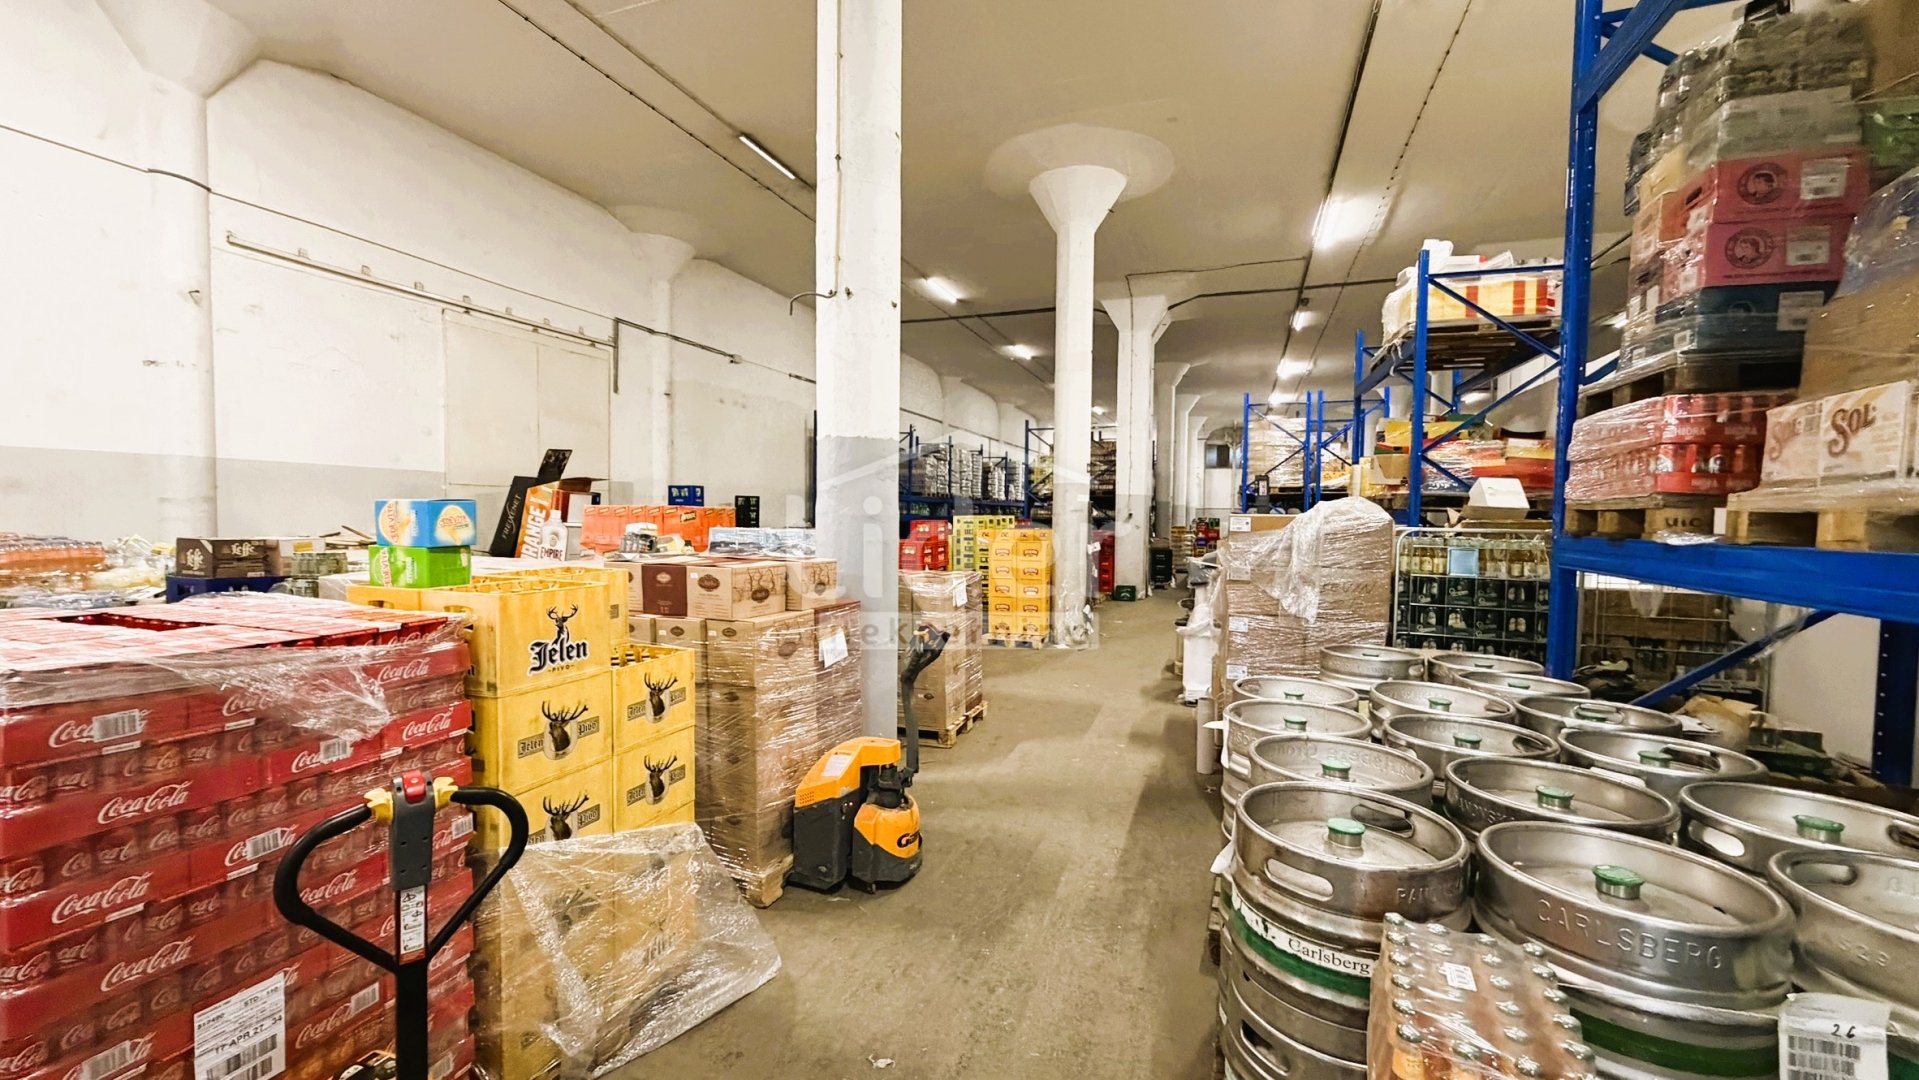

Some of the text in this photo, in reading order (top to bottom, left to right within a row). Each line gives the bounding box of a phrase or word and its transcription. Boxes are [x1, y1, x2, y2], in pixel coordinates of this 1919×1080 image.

[529, 638, 587, 674] Jelen
[1537, 898, 1724, 970] CARLSBERG
[1288, 937, 1371, 976] Carlsberg
[229, 1031, 251, 1047] APR
[252, 1023, 265, 1035] 27
